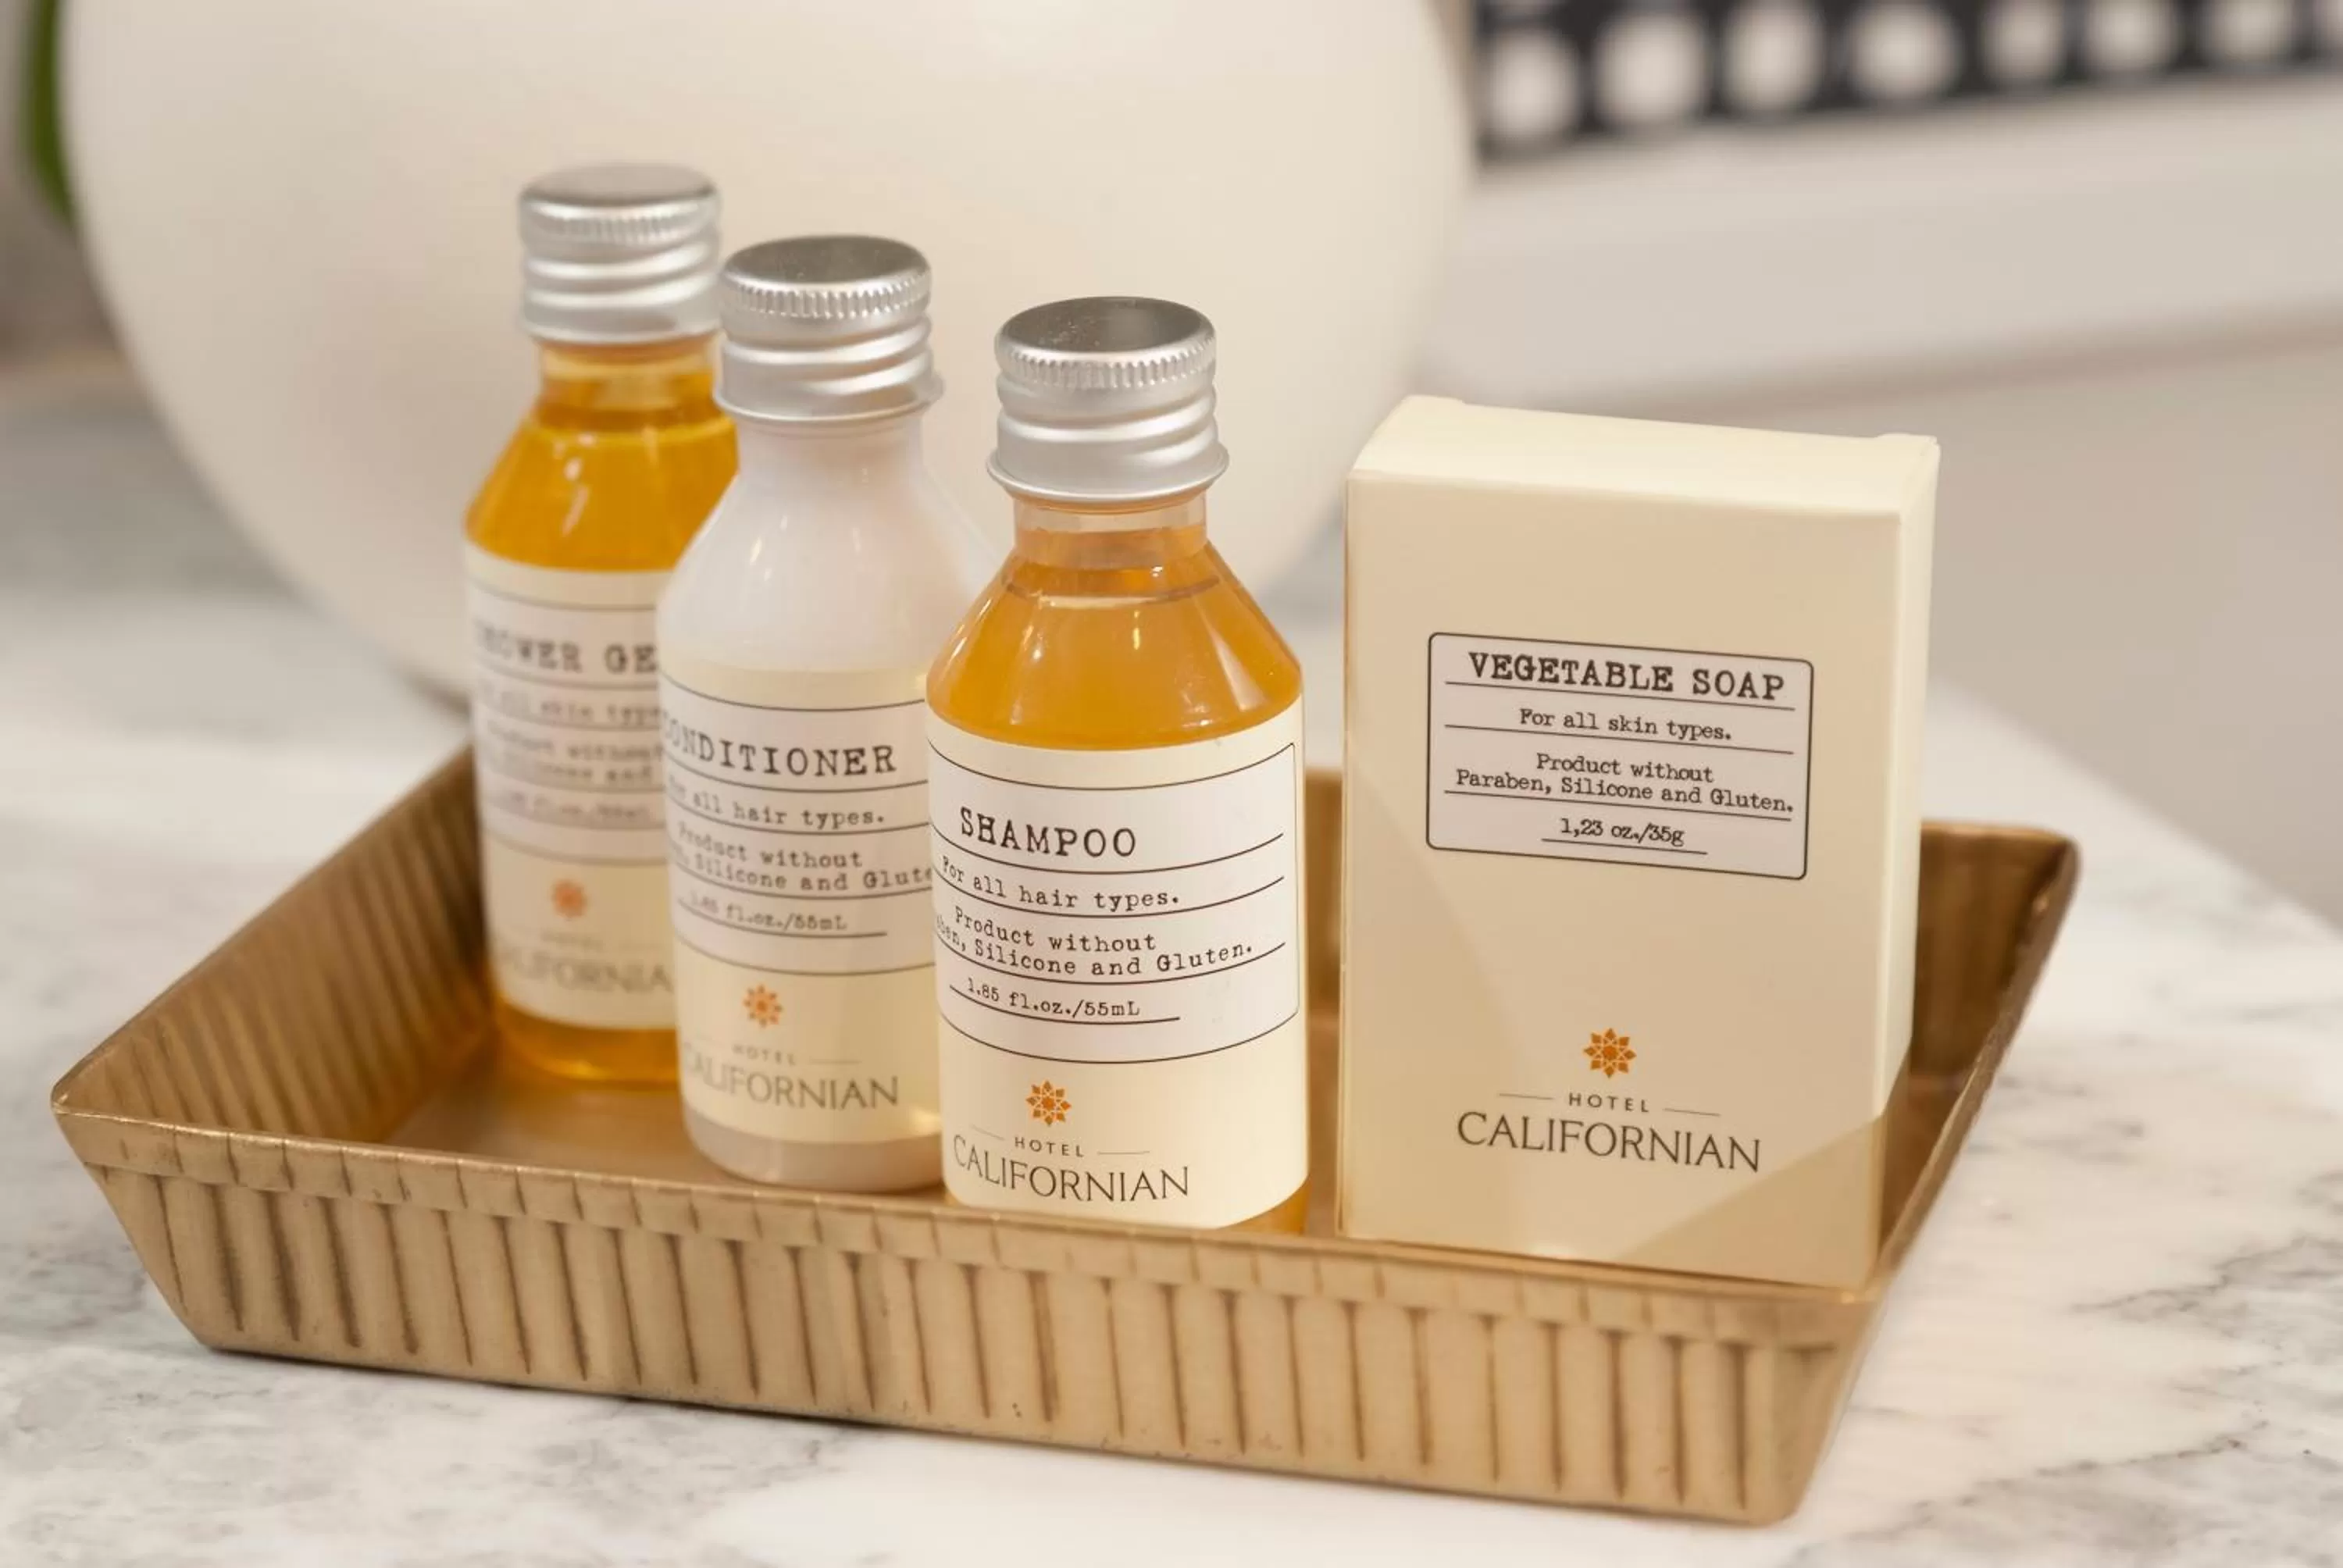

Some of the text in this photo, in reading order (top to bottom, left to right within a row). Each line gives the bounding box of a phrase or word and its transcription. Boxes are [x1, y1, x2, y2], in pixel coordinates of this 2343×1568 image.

[474, 618, 658, 675] HOWER GE
[1468, 651, 1785, 701] VEGETABLE SOAP
[1519, 708, 1731, 742] For all skin types.
[1535, 753, 1716, 783] Product without
[693, 789, 722, 814] all
[733, 801, 788, 825] hair
[801, 811, 885, 830] types.
[1456, 768, 1795, 813] Paraben, Silicone and Gluten.
[678, 820, 748, 863] Product
[759, 850, 863, 869] without
[960, 806, 1137, 857] SHAMPOO
[1560, 818, 1685, 848] 1,23 oz./35g
[694, 853, 932, 891] Silicone and Glute
[942, 855, 1181, 914] For all hair types.
[955, 905, 1157, 952] Product without
[975, 938, 1076, 975] Silicone
[1091, 957, 1141, 976] and
[1157, 943, 1254, 972] Gluten.
[967, 977, 1141, 1018] 1.85 fl.oz./55mL
[731, 1043, 797, 1067] HOTEL
[1568, 1092, 1649, 1113] HOTEL
[1014, 1136, 1085, 1157] HOTEL
[1457, 1110, 1761, 1173] CALIFORNIAN
[953, 1134, 1189, 1202] CALIFORNIAN
